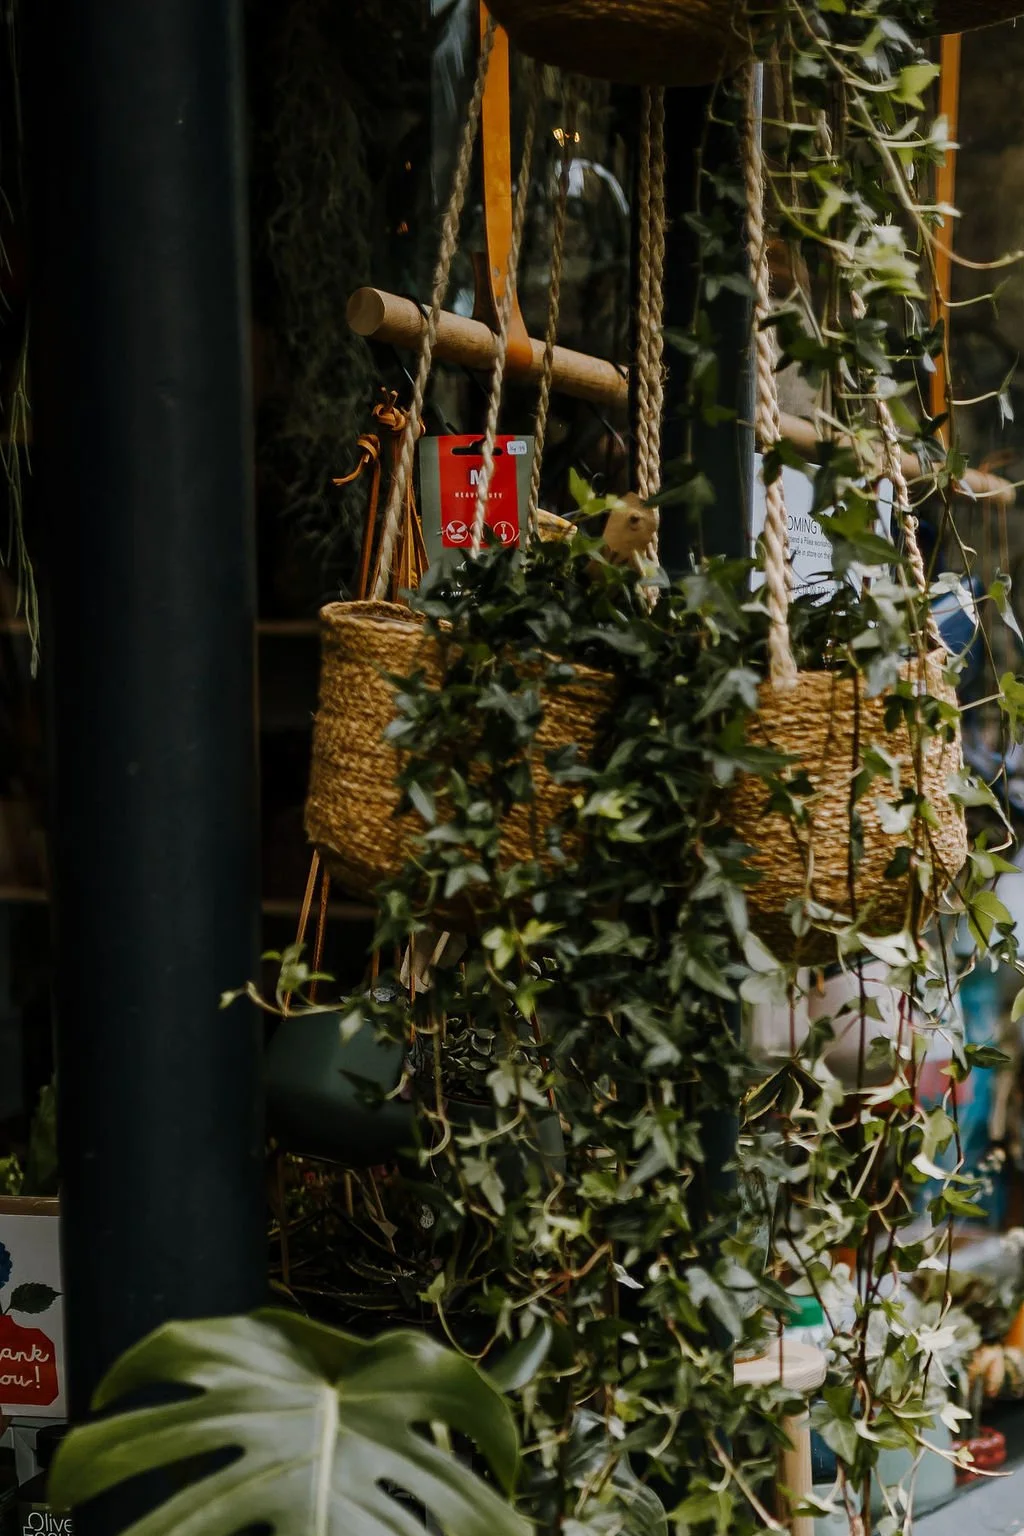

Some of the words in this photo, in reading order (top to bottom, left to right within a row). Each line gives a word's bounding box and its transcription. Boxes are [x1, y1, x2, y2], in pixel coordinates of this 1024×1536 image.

[787, 515, 818, 535] OMING
[815, 539, 832, 549] worksho
[0, 1343, 49, 1362] ank
[0, 1365, 40, 1389] ou!
[28, 1512, 72, 1533] Olive
